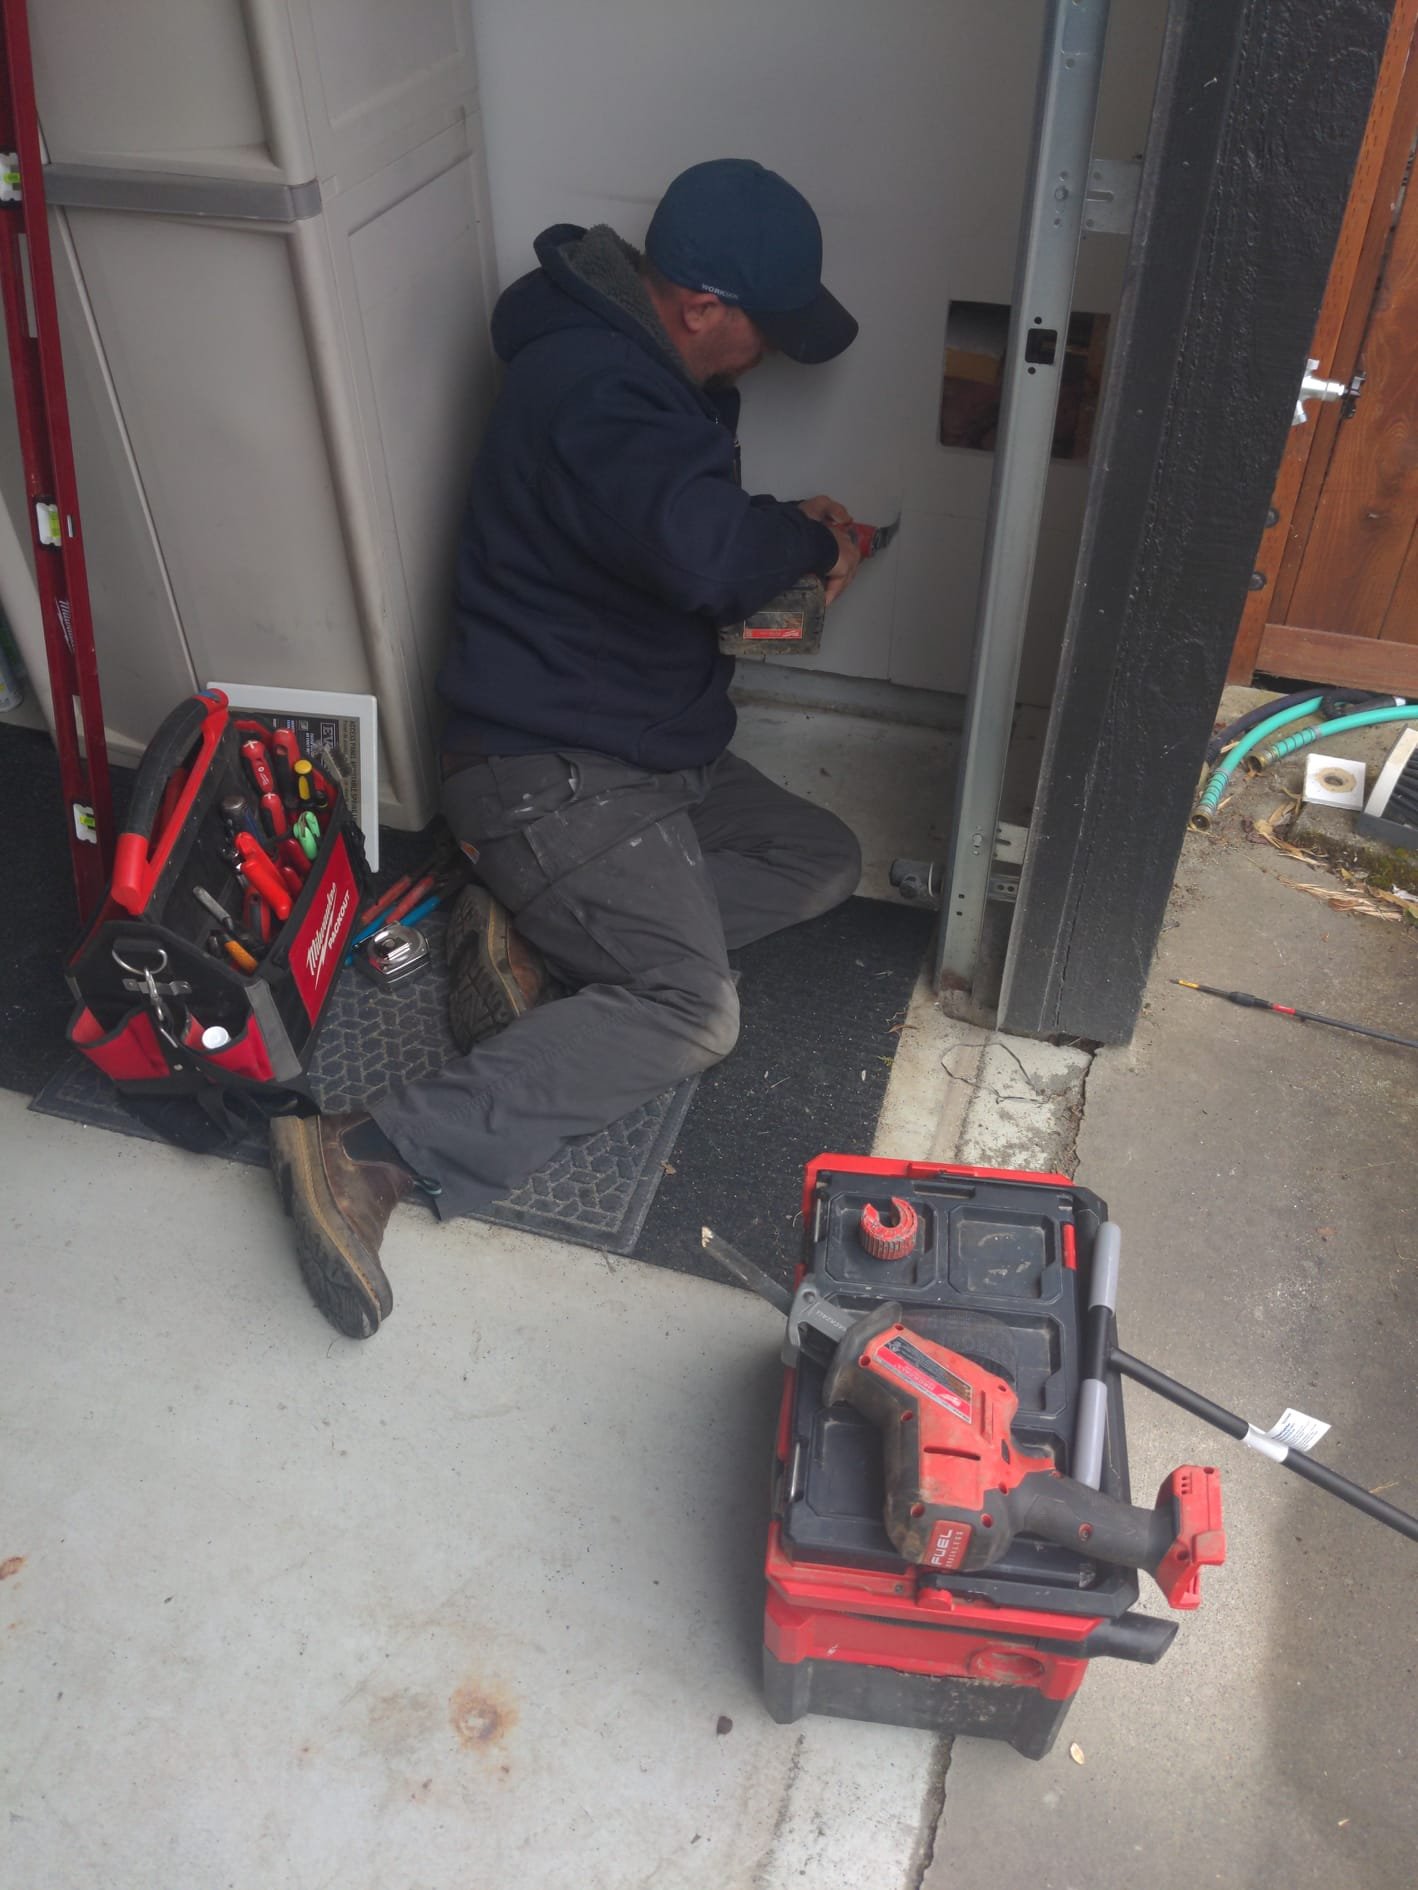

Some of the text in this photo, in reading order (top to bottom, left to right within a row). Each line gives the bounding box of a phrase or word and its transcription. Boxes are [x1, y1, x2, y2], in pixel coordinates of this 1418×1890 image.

[306, 882, 337, 976] Milwaukee
[327, 889, 350, 950] PACKOUT
[931, 1528, 954, 1566] FUEL
